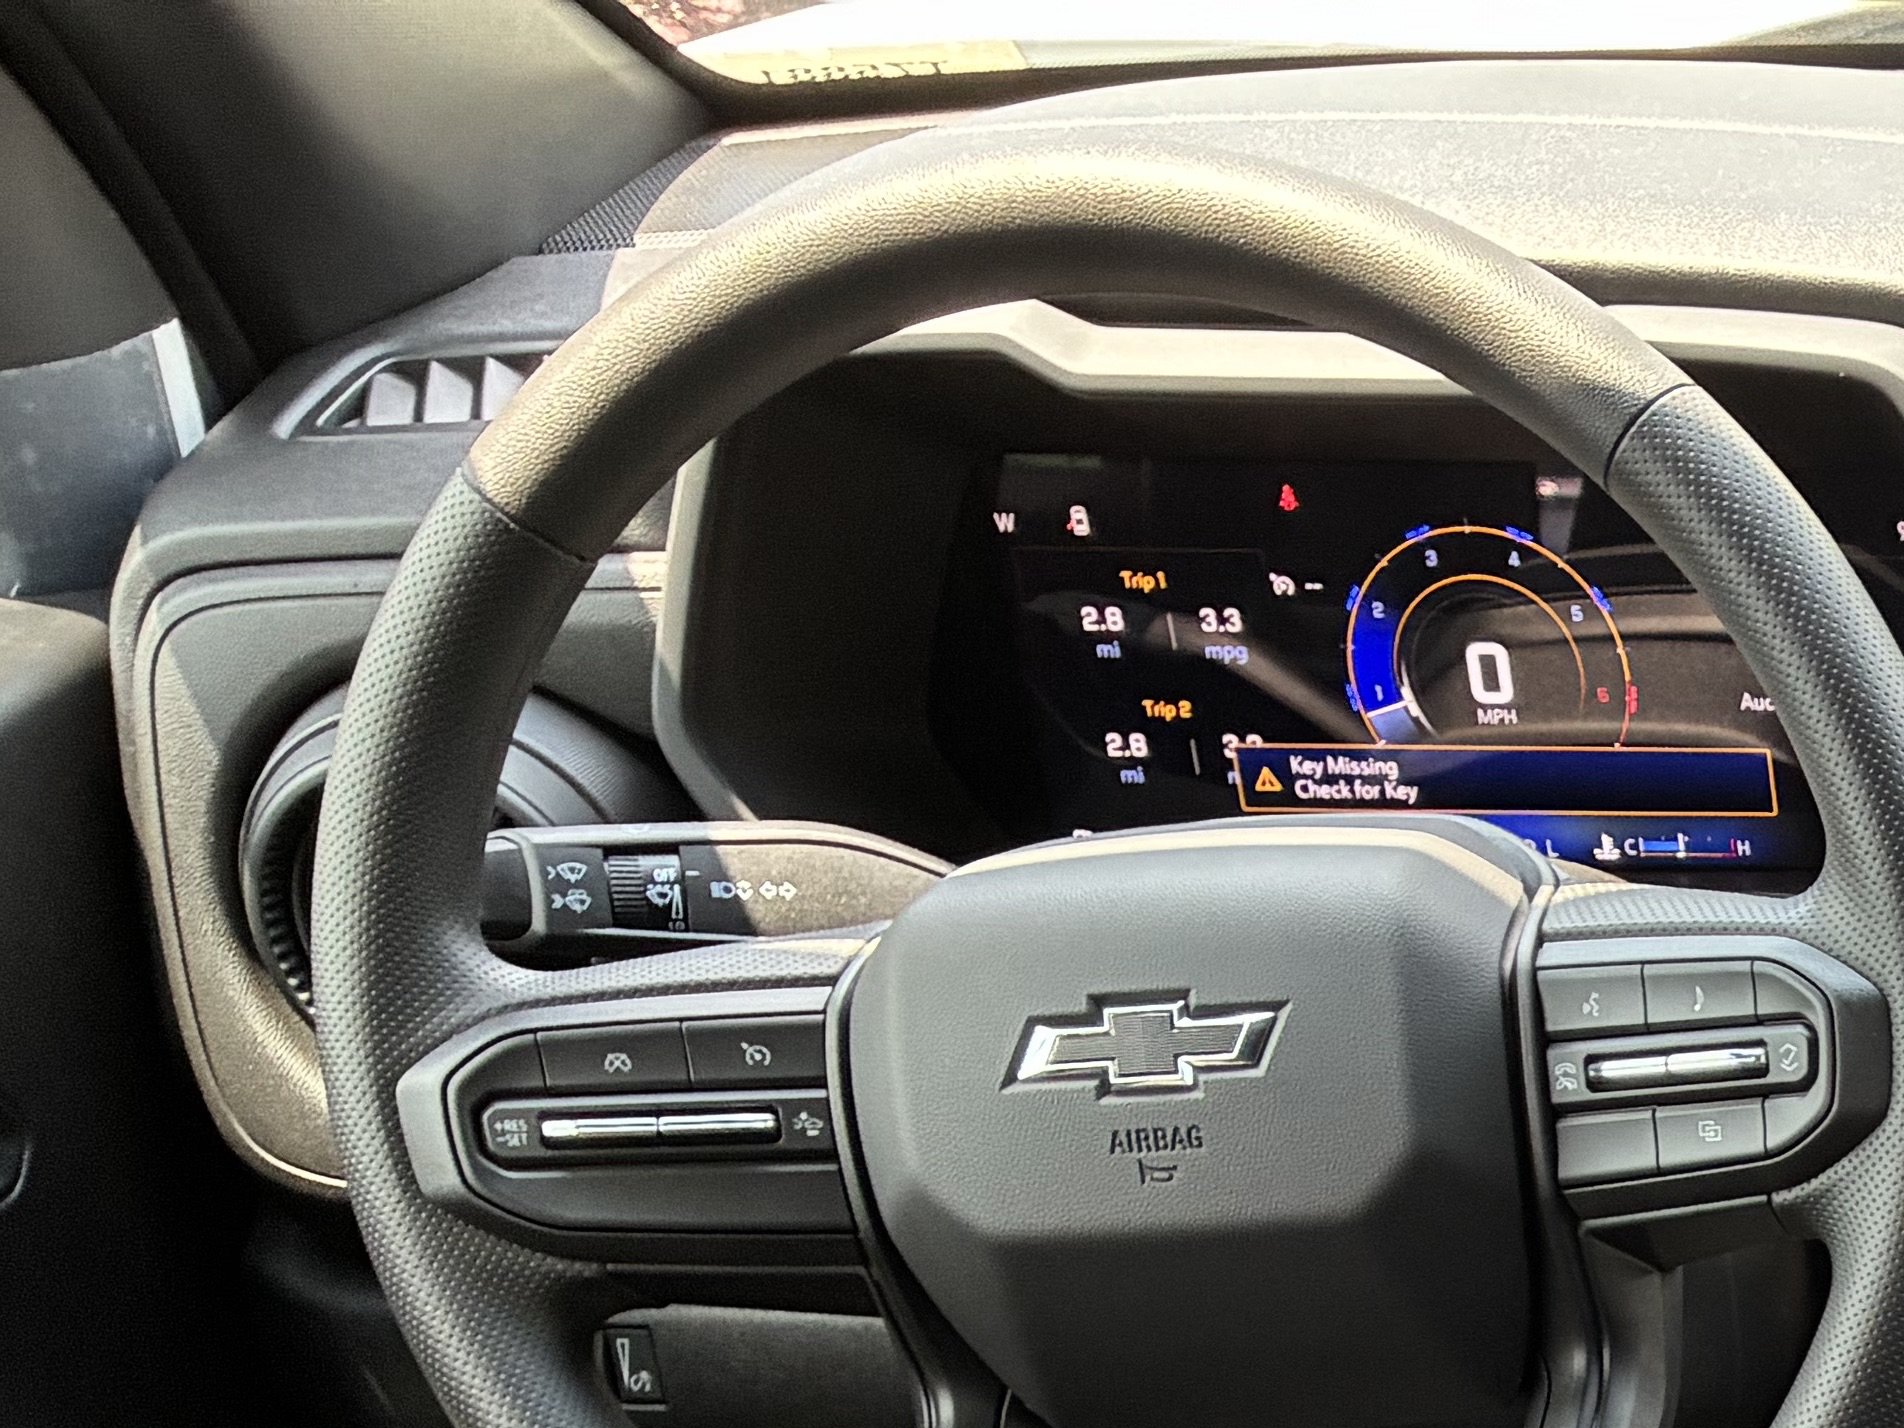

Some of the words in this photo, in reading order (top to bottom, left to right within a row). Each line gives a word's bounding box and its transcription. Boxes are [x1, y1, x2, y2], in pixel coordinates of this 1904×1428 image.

[993, 512, 1015, 533] W
[1424, 550, 1439, 568] 3
[1508, 551, 1522, 568] 4
[1119, 570, 1155, 593] Trip
[1156, 570, 1167, 589] 1
[1080, 606, 1125, 632] 2.8
[1372, 601, 1385, 618] 2
[1570, 605, 1584, 622] 5
[1199, 607, 1243, 633] 3.3
[1096, 640, 1121, 658] mi
[1204, 643, 1249, 664] mpg
[1465, 641, 1515, 705] 0
[1375, 684, 1384, 702] 1
[1141, 699, 1176, 722] Trip
[1178, 700, 1193, 718] 2
[1477, 708, 1518, 725] MPH
[1105, 732, 1149, 758] 2.8
[1120, 766, 1146, 784] mi
[1289, 755, 1324, 779] Key
[1326, 755, 1400, 780] Missing
[1294, 779, 1354, 800] Check
[1354, 780, 1381, 800] for
[1384, 780, 1419, 805] Key
[1624, 838, 1637, 856] C
[1737, 839, 1751, 857] H
[653, 867, 678, 882] OFF
[1109, 1125, 1204, 1156] AIRBAG
